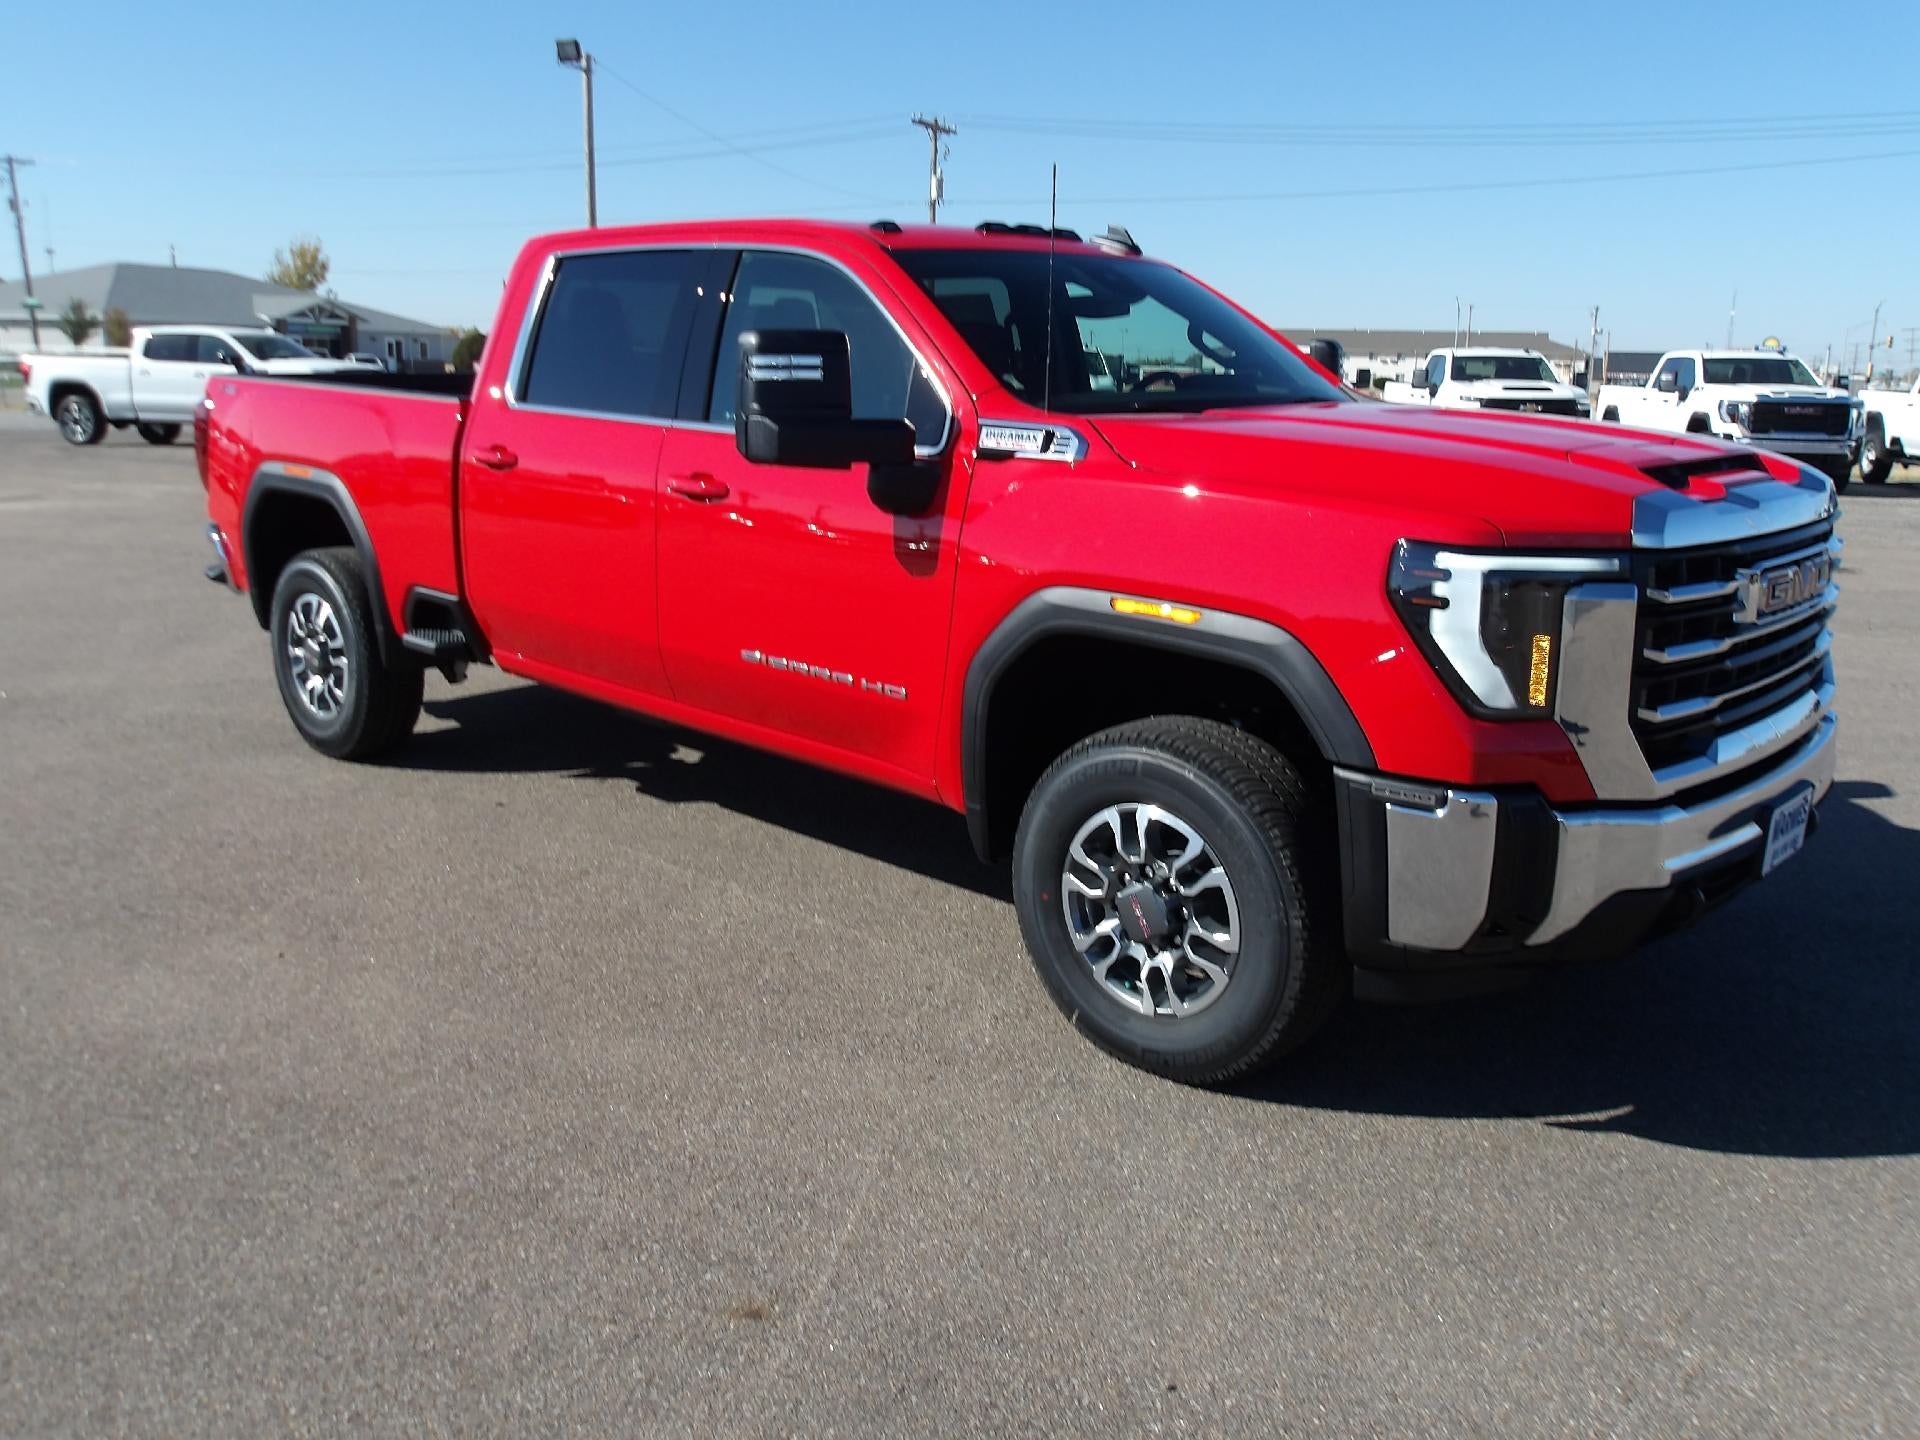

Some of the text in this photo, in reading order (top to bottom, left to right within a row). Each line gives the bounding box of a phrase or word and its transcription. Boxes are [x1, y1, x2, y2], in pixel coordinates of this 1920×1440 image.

[1758, 552, 1830, 613] GMC
[741, 649, 906, 700] SIERRA HD
